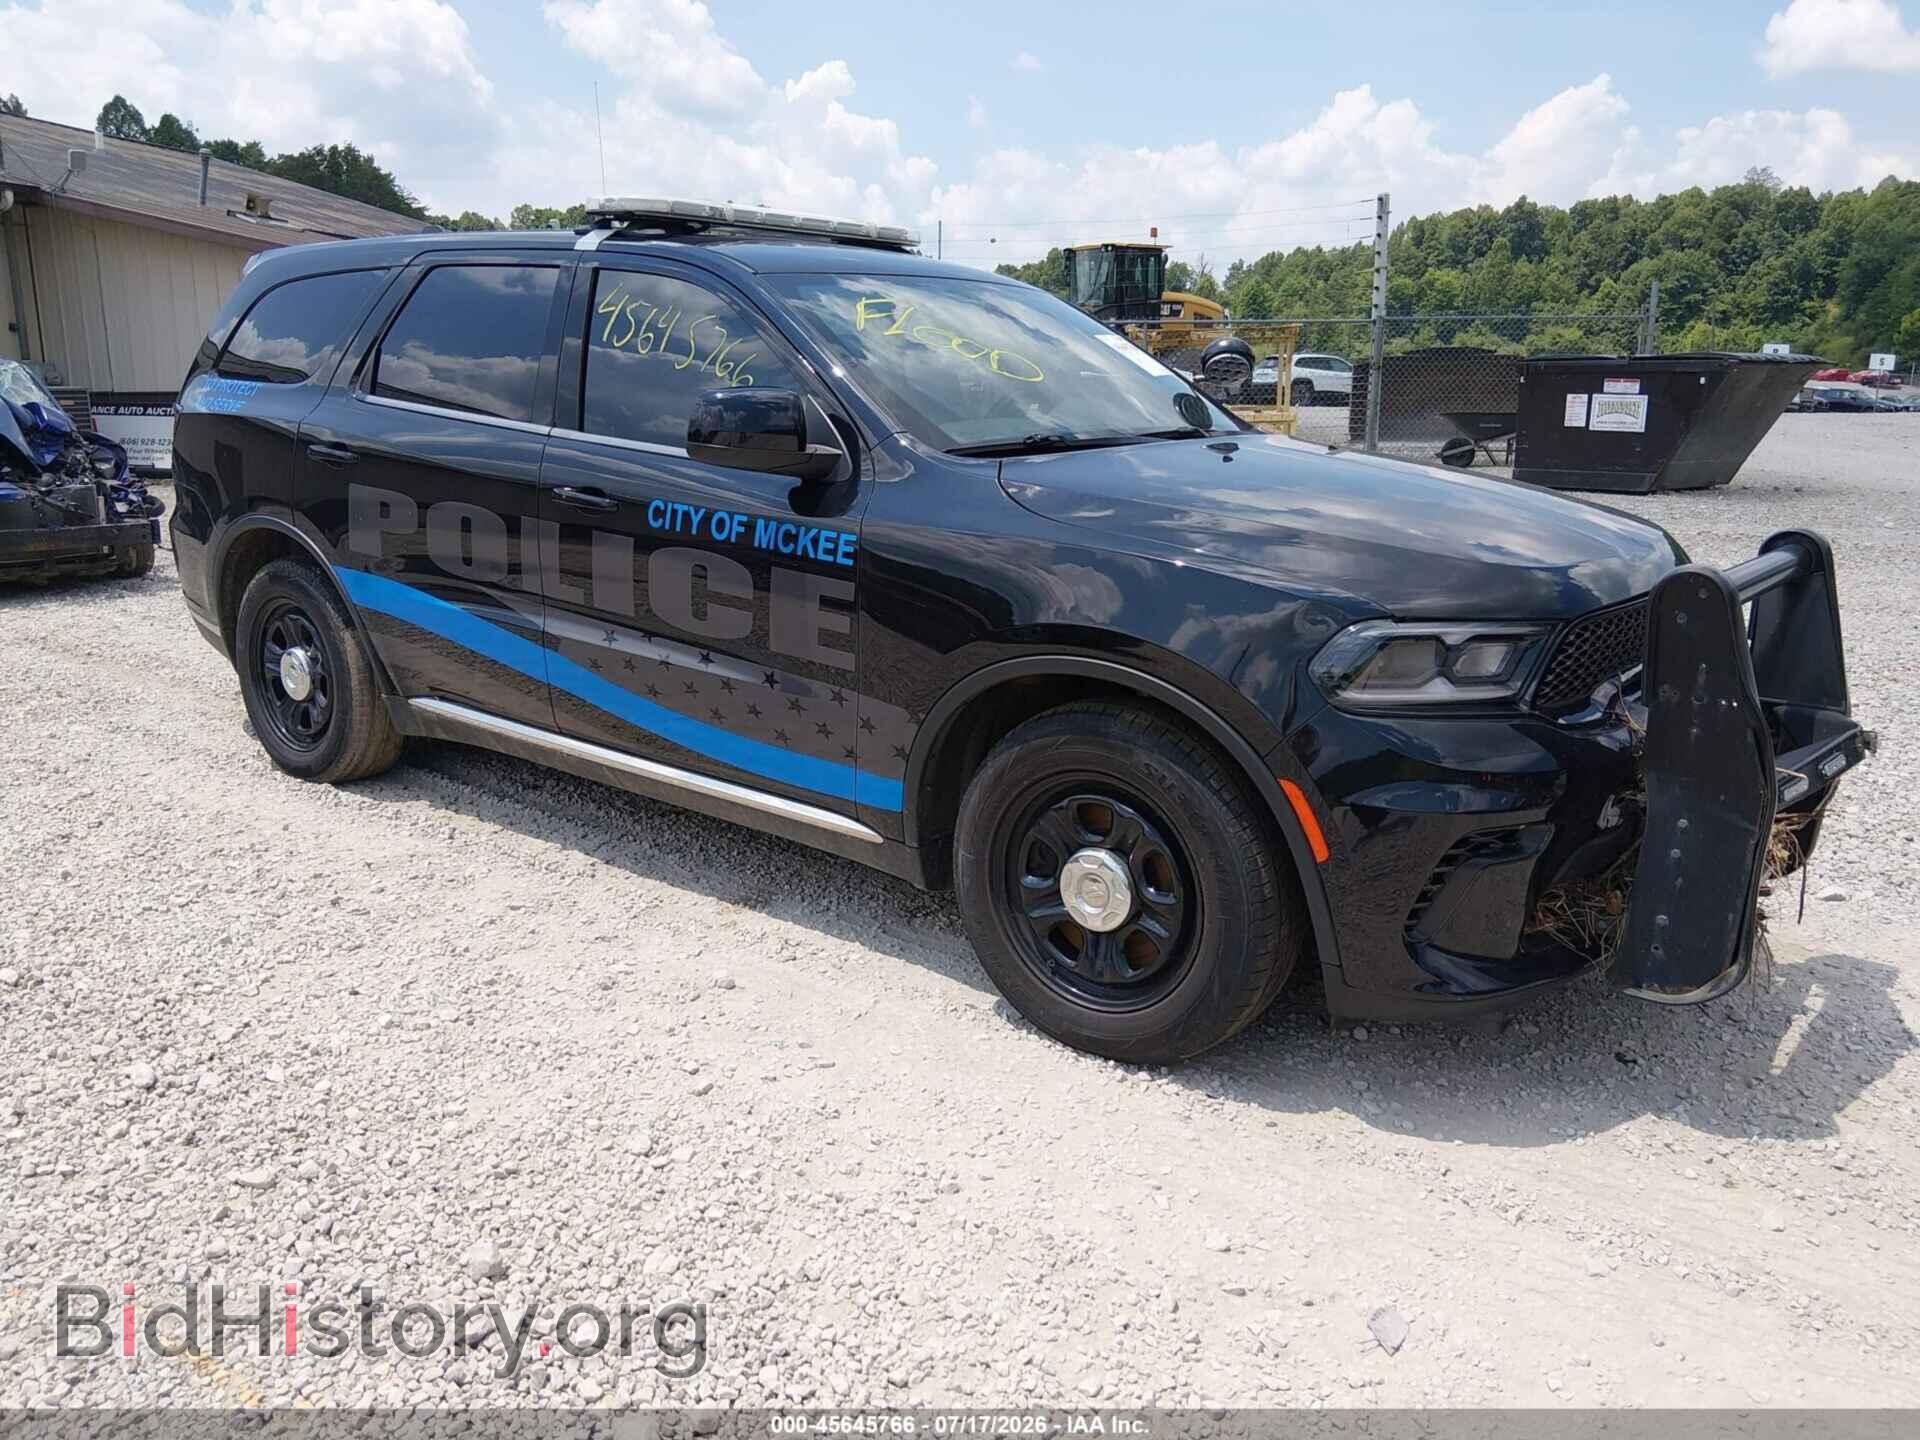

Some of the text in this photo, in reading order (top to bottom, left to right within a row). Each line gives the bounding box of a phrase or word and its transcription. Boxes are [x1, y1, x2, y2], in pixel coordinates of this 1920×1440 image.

[598, 282, 758, 388] 45645766
[856, 297, 1045, 382] FLOOD
[91, 406, 175, 416] ANCE AUTO AUCTI
[648, 499, 858, 567] CITY OF MCKEE
[347, 482, 856, 672] POLICE
